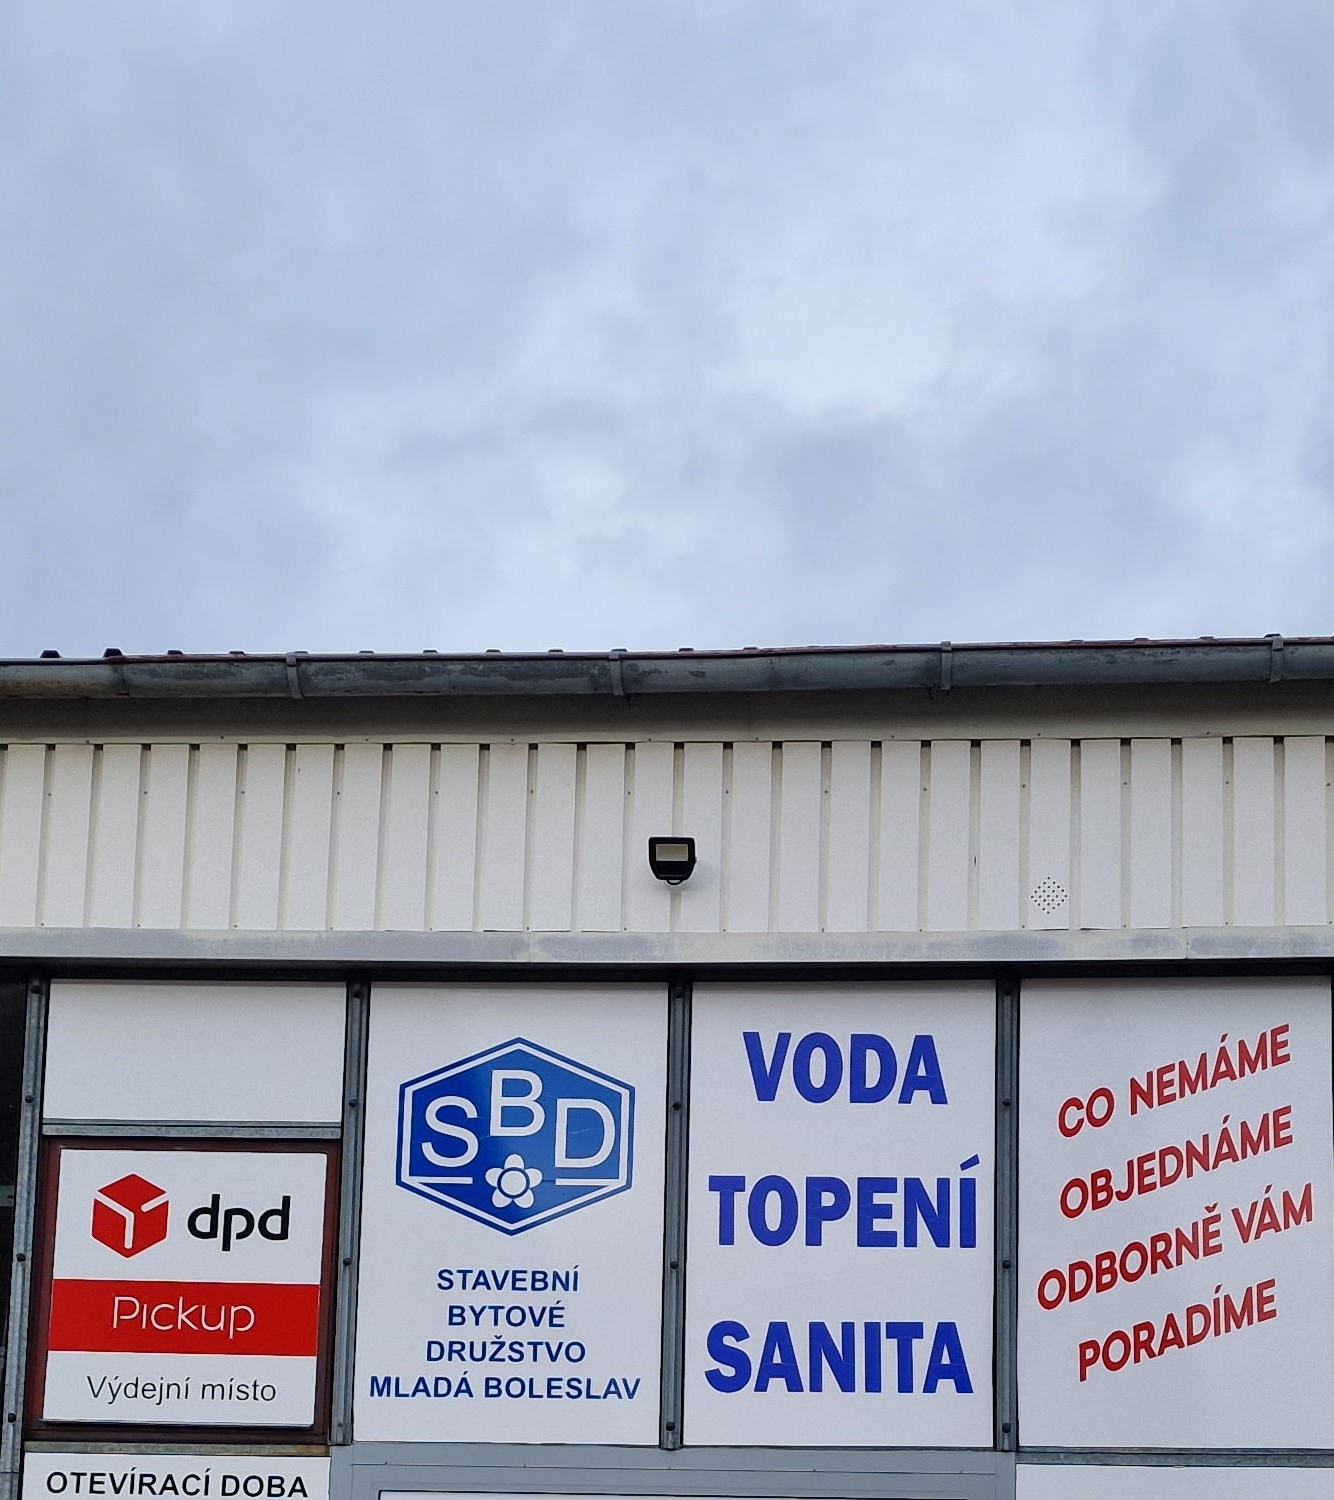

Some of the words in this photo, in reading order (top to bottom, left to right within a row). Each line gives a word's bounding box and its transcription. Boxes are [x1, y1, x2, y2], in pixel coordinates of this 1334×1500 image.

[743, 1032, 948, 1104] VODA
[1058, 1087, 1114, 1138] CO
[1130, 1023, 1291, 1115] NEMÁME
[421, 1068, 616, 1168] SBD
[1060, 1105, 1293, 1218] OBJEDNÁME
[188, 1194, 291, 1251] dpd
[709, 1154, 980, 1248] TOPENÍ
[437, 1265, 579, 1291] STAVEBNÍ
[1037, 1202, 1222, 1310] ODBORNĚ
[1232, 1183, 1313, 1244] VÁM
[112, 1296, 255, 1339] Pickup
[449, 1300, 565, 1327] BYTOVÉ
[1079, 1278, 1277, 1382] PORADÍME
[427, 1335, 585, 1362] DRUŽSTVO
[705, 1321, 974, 1393] SANITA
[87, 1376, 190, 1405] Výdejní
[202, 1378, 276, 1401] místo
[370, 1371, 474, 1397] MLADÁ
[485, 1377, 640, 1399] BOLESLAV
[47, 1467, 210, 1496] OTEVÍRACÍ
[221, 1475, 308, 1497] DOBA
